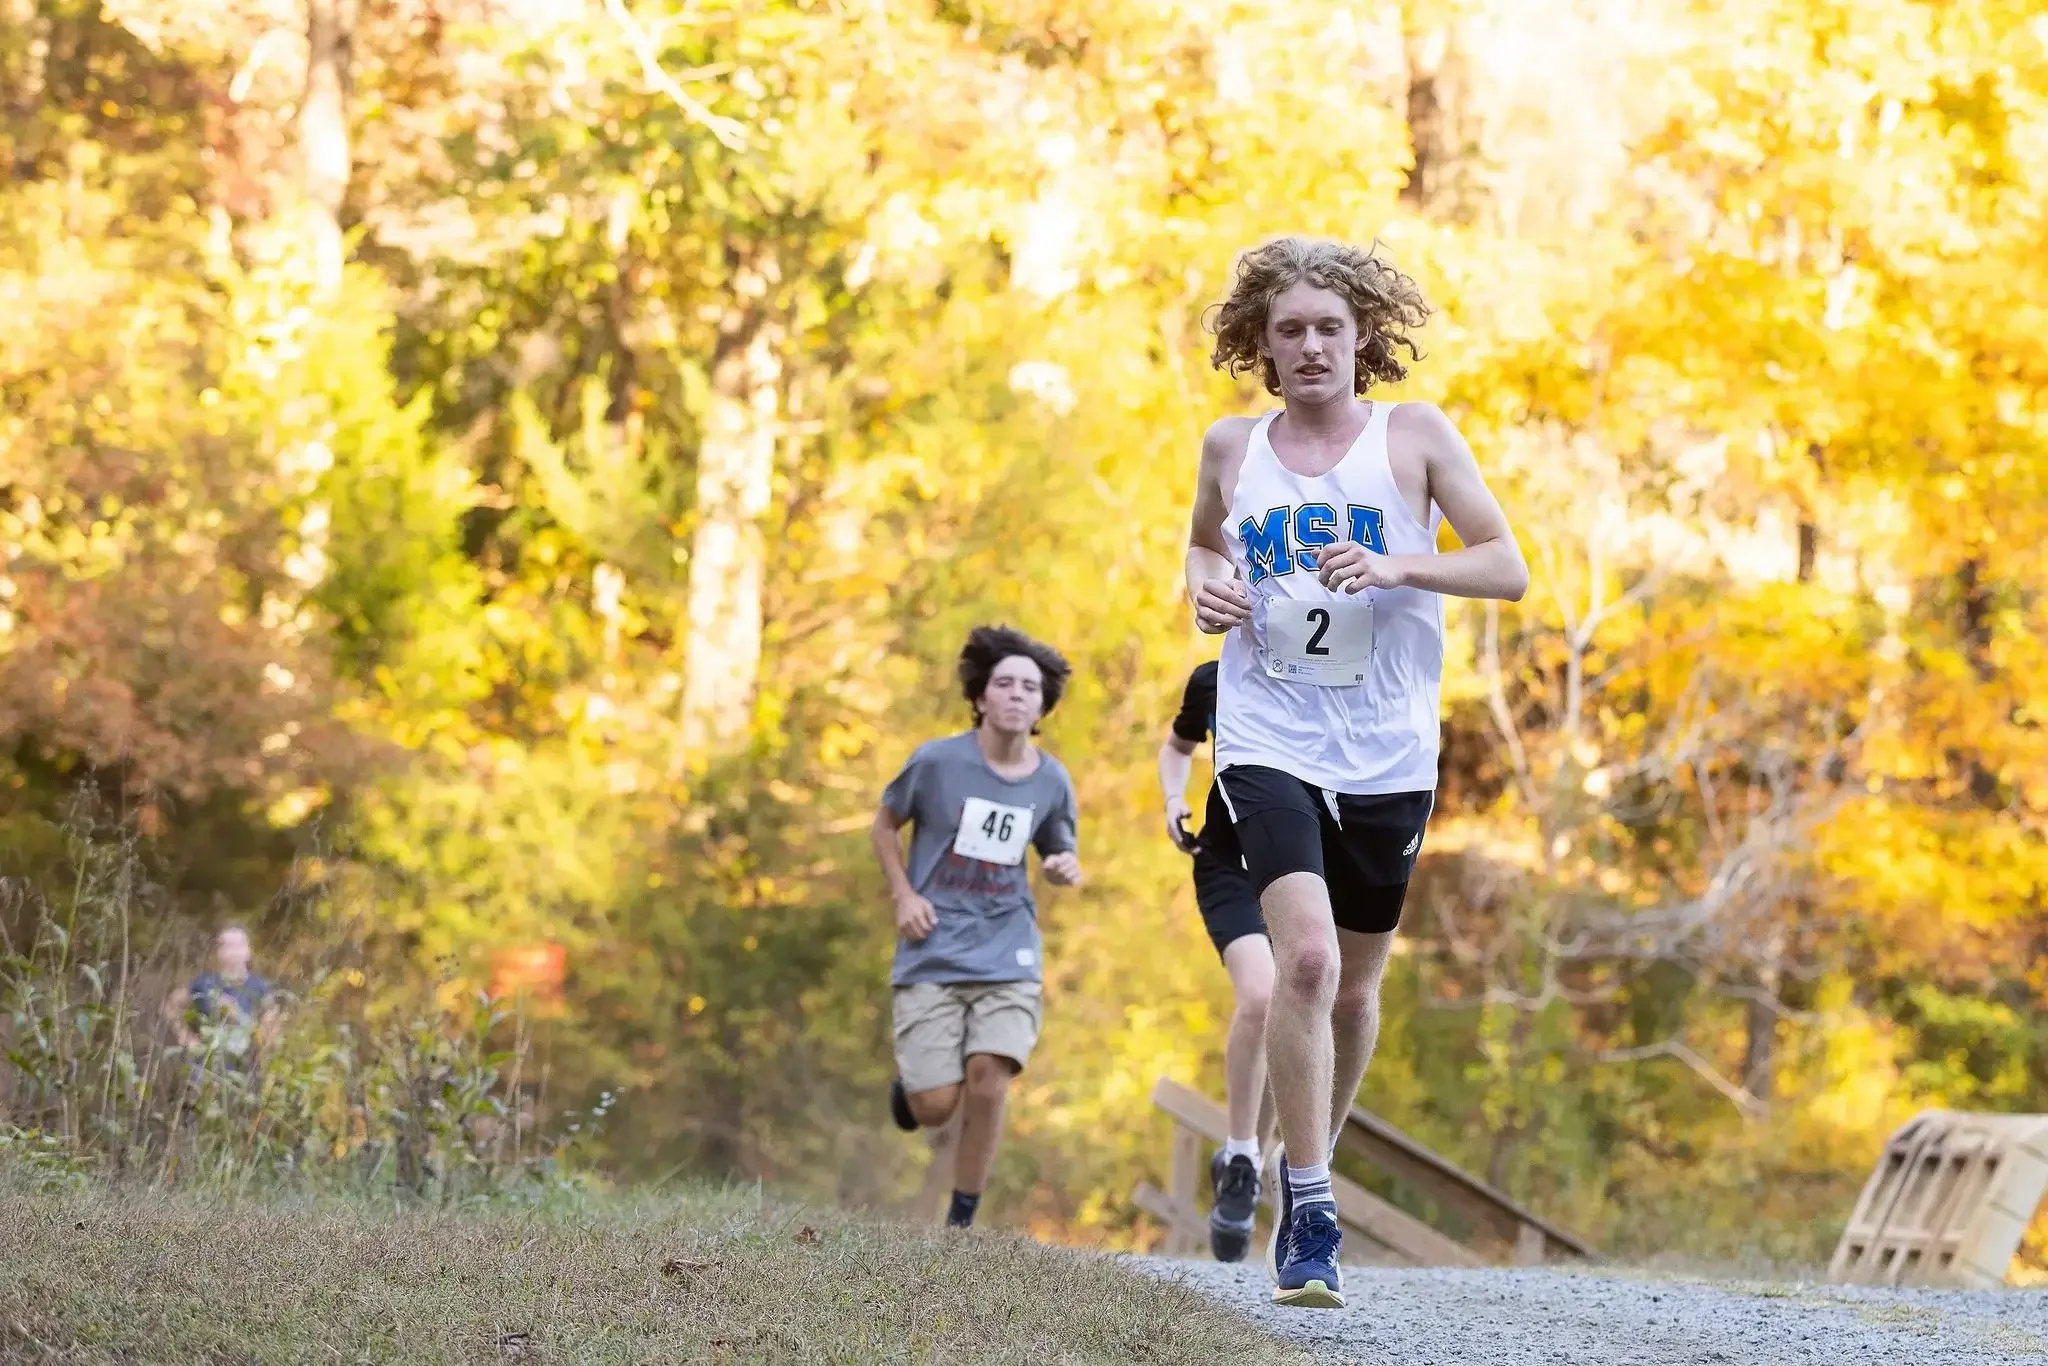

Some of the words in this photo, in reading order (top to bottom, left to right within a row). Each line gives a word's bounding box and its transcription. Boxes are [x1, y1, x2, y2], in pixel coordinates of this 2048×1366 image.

[1239, 503, 1388, 586] MSA
[1305, 608, 1331, 656] 2
[982, 811, 1015, 842] 46
